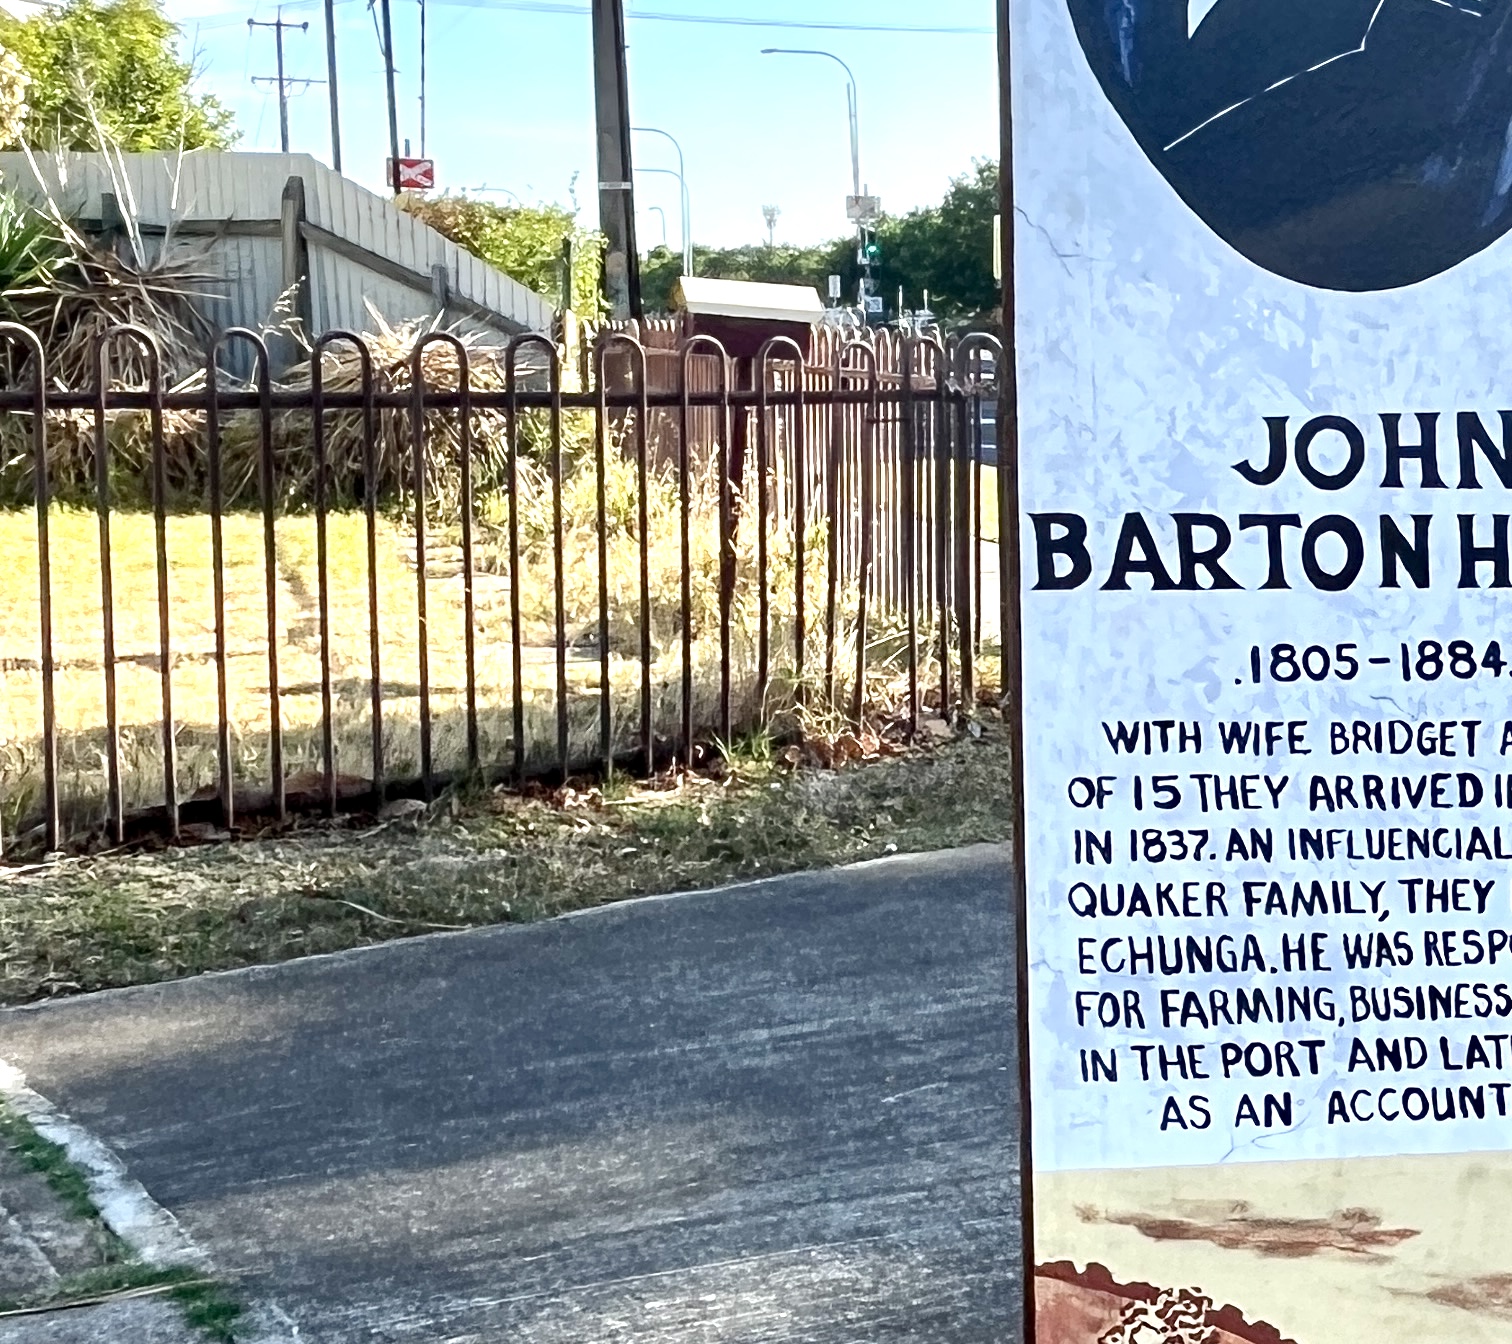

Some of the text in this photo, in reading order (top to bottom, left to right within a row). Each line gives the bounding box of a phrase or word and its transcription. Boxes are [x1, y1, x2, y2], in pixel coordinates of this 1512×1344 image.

[1026, 511, 1434, 592] BARTON
[1101, 719, 1202, 755] WITH
[1218, 719, 1312, 757] WIFE
[1329, 719, 1482, 758] BRIDGET
[1067, 775, 1118, 810] OF
[1132, 774, 1183, 811] 15
[1189, 772, 1291, 813] THEY
[1308, 772, 1484, 813] ARRIVED
[1074, 829, 1112, 866] IN
[1129, 827, 1218, 864] 1837.
[1224, 826, 1273, 863] AN
[1066, 879, 1229, 919] QUAKER
[1242, 878, 1391, 923] FAMILY,
[1396, 877, 1496, 915] THEY
[1077, 932, 1279, 976] ECHUNGA.
[1282, 931, 1333, 973] HE
[1342, 930, 1415, 971] WAS
[1074, 987, 1146, 1030] FOR
[1159, 984, 1346, 1029] FARMING,
[1079, 1045, 1118, 1084] IN
[1130, 1043, 1210, 1082] THE
[1219, 1037, 1327, 1079] PORT
[1346, 1035, 1428, 1075] AND
[1159, 1091, 1212, 1132] AS
[1233, 1090, 1293, 1129] AN
